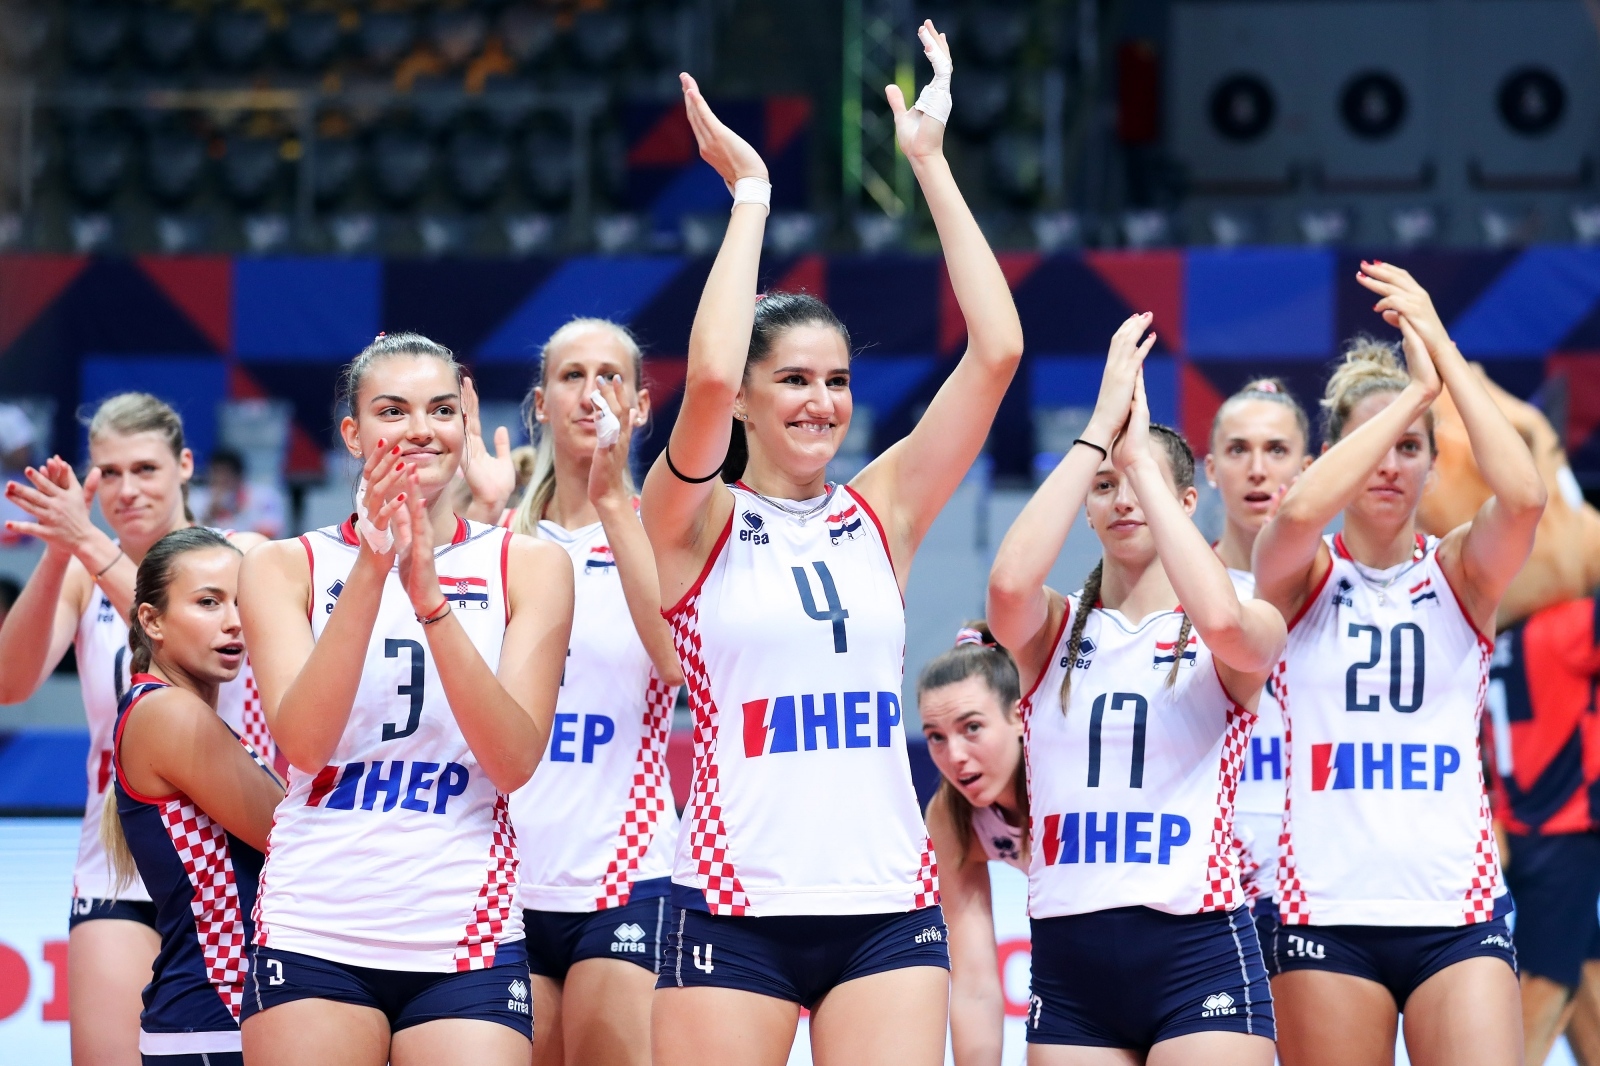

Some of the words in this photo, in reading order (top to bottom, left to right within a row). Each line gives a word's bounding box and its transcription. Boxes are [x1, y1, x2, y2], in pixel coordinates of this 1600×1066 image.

[458, 600, 490, 610] RO
[790, 560, 850, 653] 4
[1152, 658, 1196, 670] CO
[1346, 622, 1425, 713] 20
[382, 638, 425, 742] 3
[550, 713, 615, 764] EP
[801, 691, 901, 752] HEP
[1087, 692, 1148, 788] 17
[360, 760, 470, 815] HEP
[1362, 742, 1461, 791] HEP
[1084, 811, 1192, 865] HEP
[266, 958, 286, 986] 3
[610, 941, 646, 953] errea
[692, 943, 714, 974] 4
[507, 999, 529, 1015] errea
